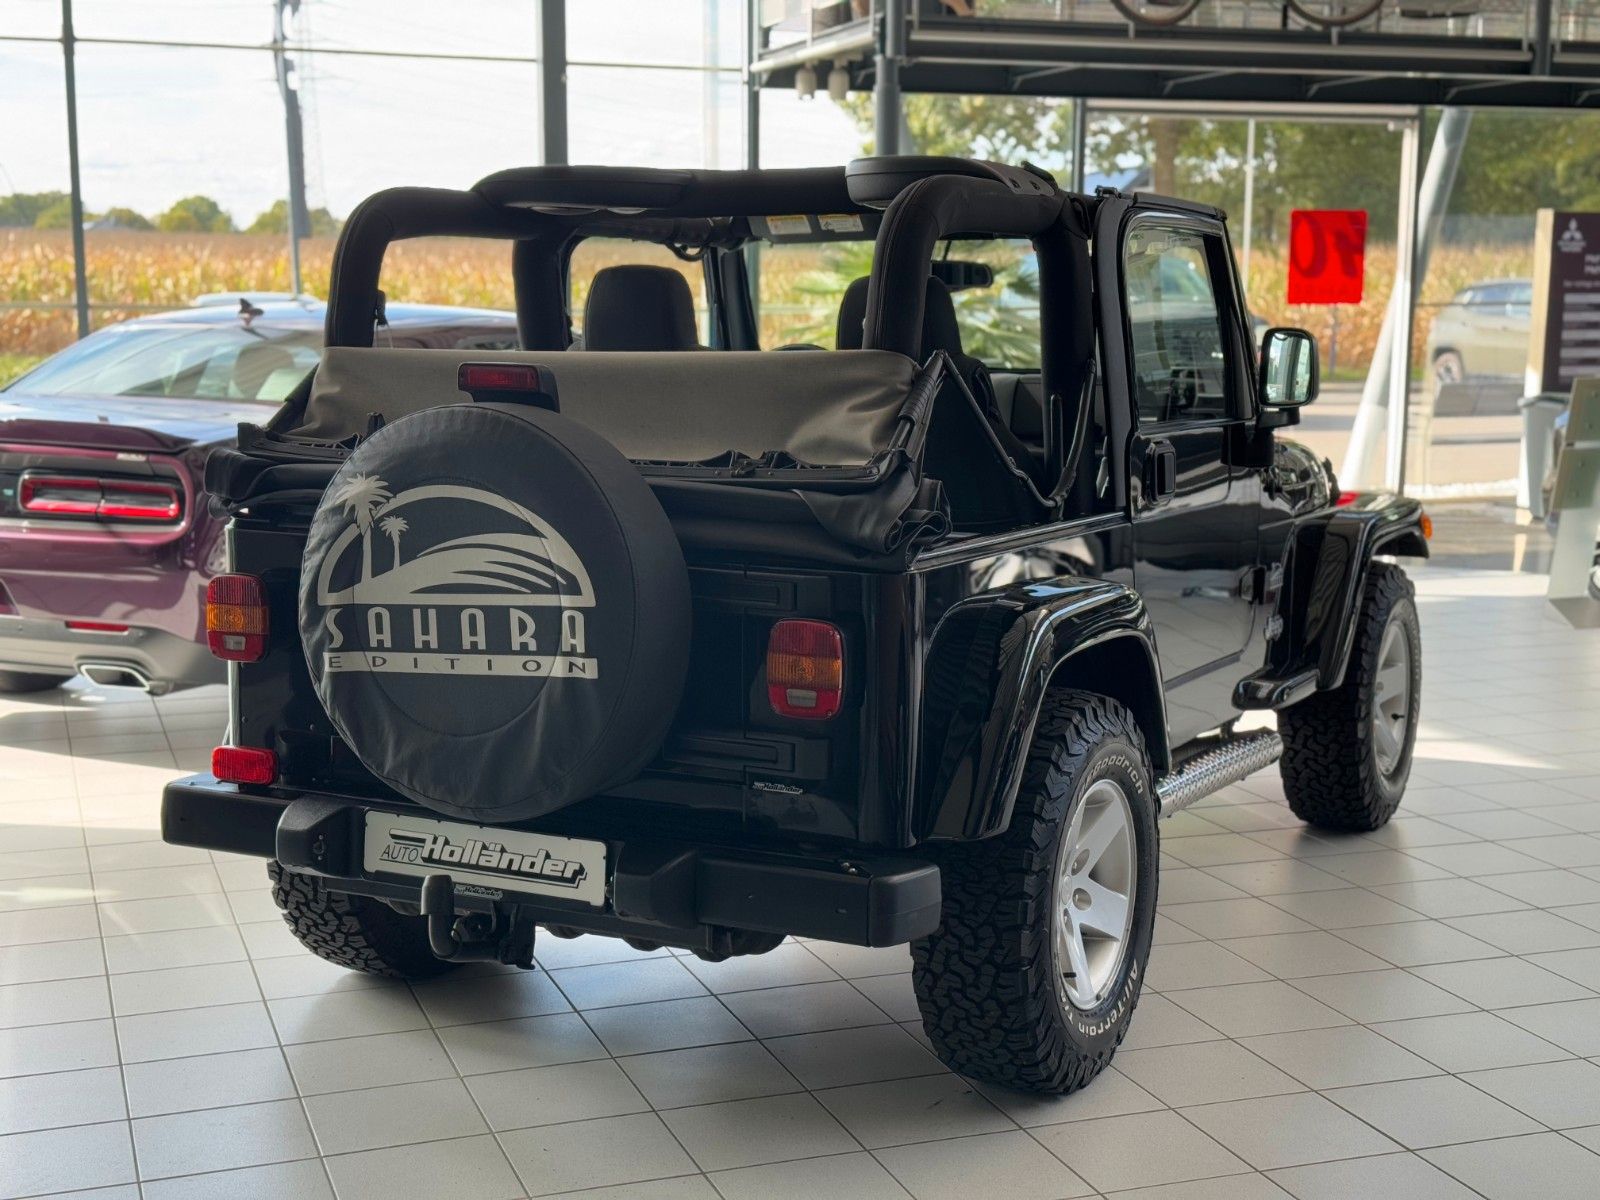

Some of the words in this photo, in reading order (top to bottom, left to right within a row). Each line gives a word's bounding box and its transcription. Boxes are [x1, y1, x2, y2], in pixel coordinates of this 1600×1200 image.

[325, 606, 585, 654] SAHARA
[328, 655, 587, 674] EDITION
[381, 843, 420, 863] AUTO
[389, 828, 586, 885] Holländer
[1078, 958, 1138, 1038] All-Terrain
